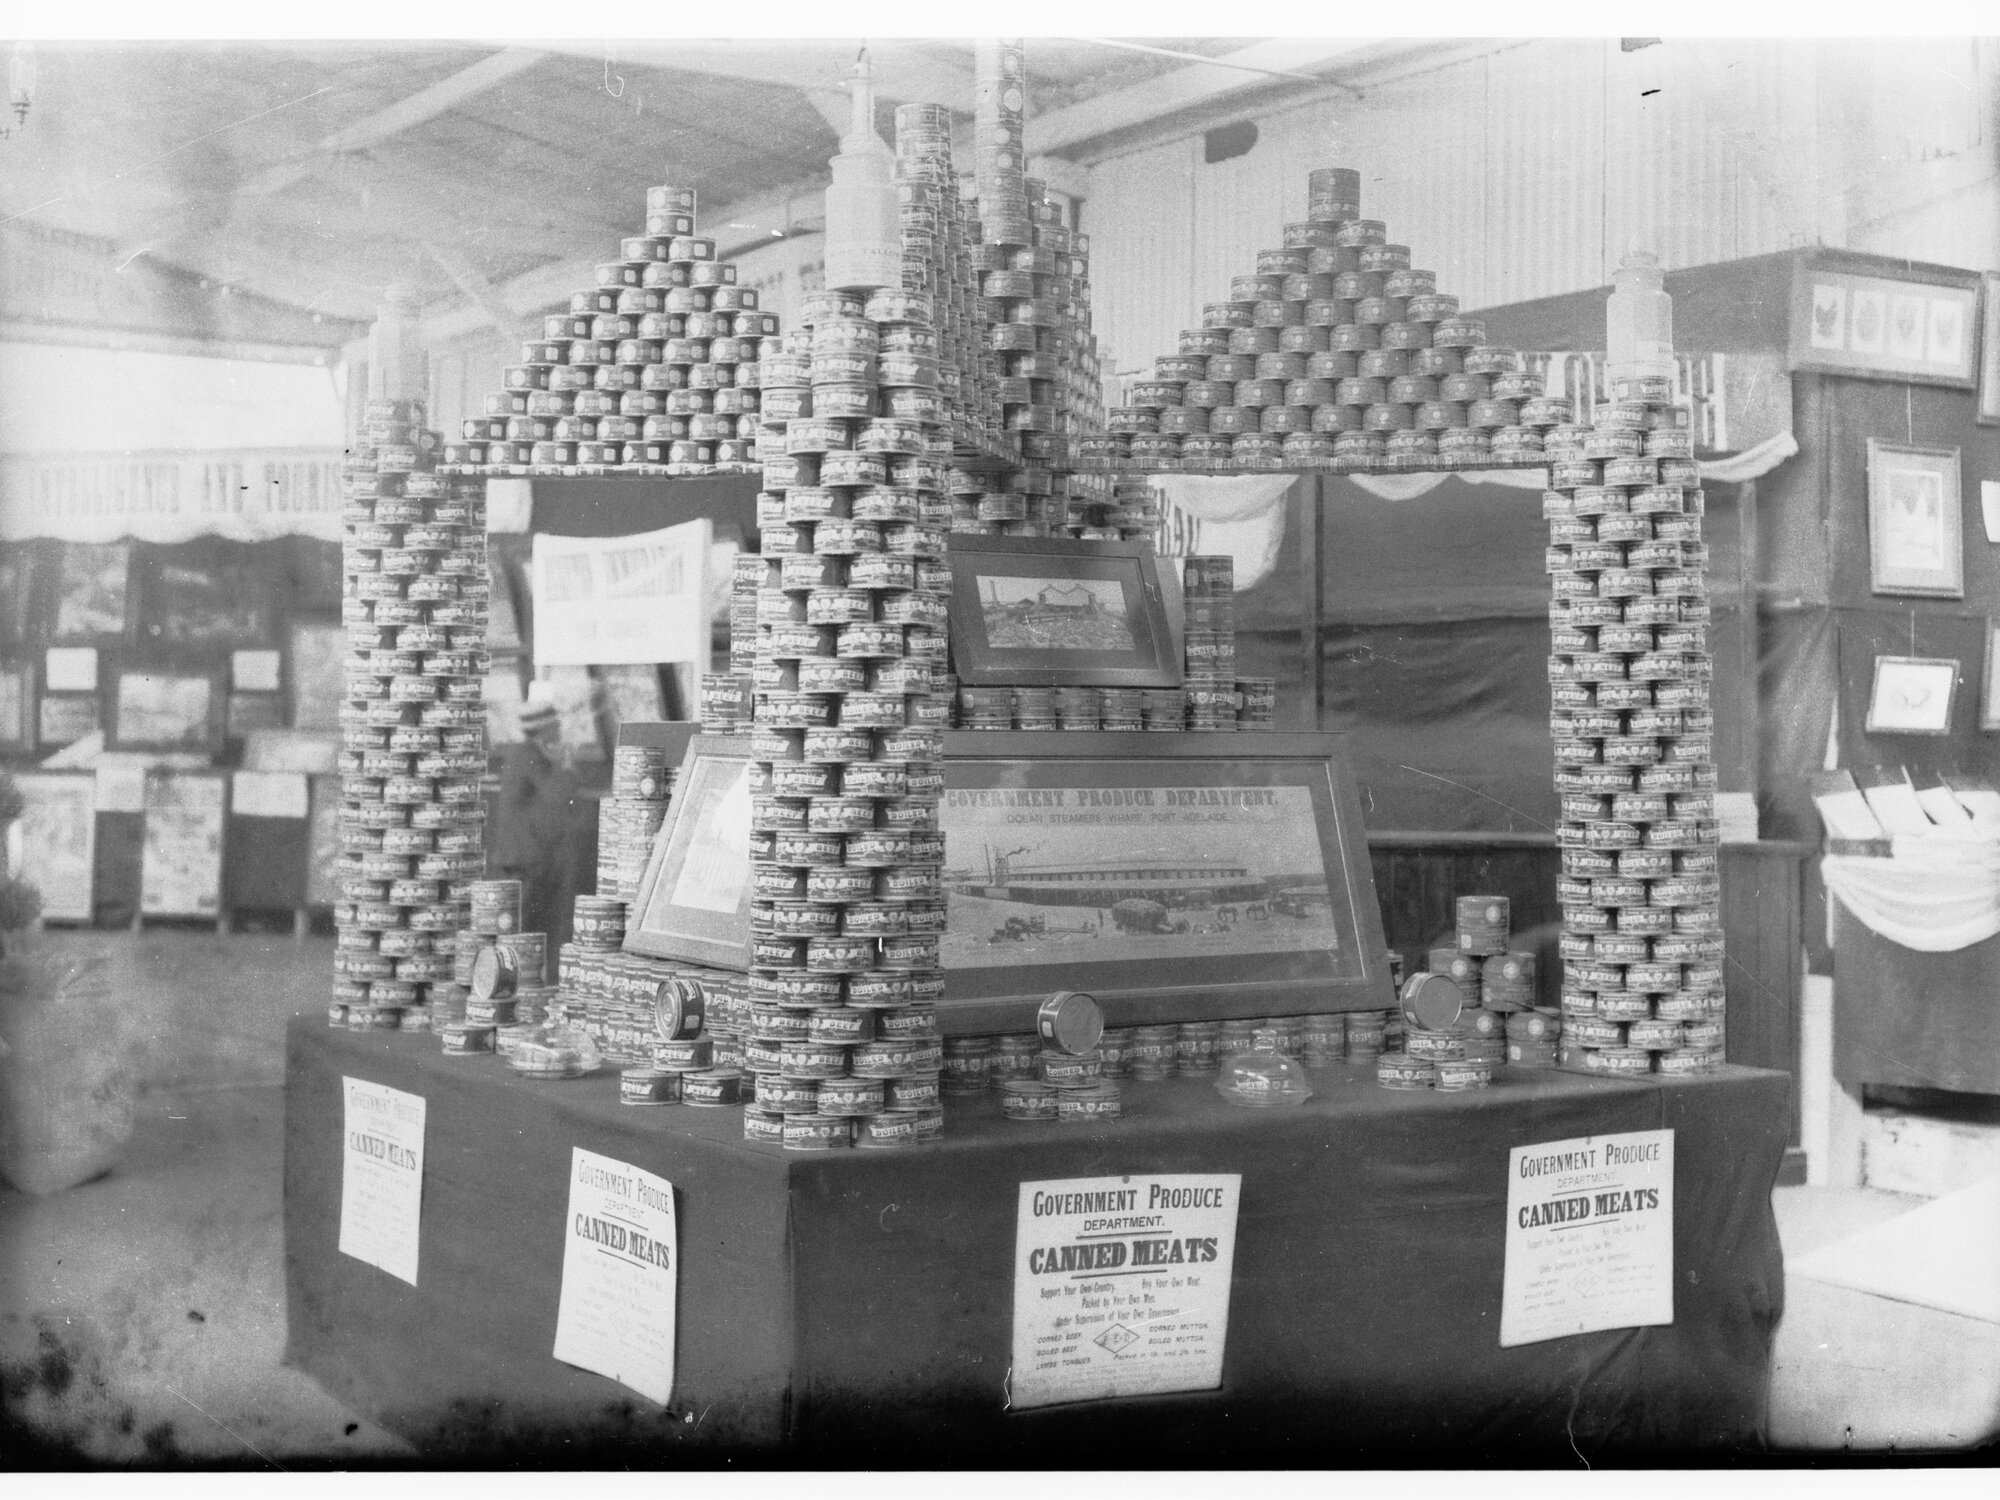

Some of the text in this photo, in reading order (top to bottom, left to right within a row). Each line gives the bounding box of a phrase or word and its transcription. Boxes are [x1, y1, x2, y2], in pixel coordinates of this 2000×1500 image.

[1077, 790, 1156, 807] PRODUCE
[1007, 813, 1043, 824] OCEAN
[1151, 812, 1176, 823] PORT
[1049, 1066, 1081, 1076] CORNED
[350, 1131, 386, 1160] CANNED
[1520, 1143, 1660, 1179] GOVERNMENT PRODUCE
[578, 1159, 669, 1214] GOVERNMENT PRODUCE
[1033, 1184, 1223, 1217] GOVERNMENT PRODUCE
[1083, 1216, 1165, 1232] DEPARTMENT.
[1518, 1188, 1659, 1229] CANNED MEATS
[575, 1212, 670, 1270] CANNED MEATS
[1029, 1237, 1218, 1275] CANNED MEATS
[1064, 1285, 1077, 1296] Your
